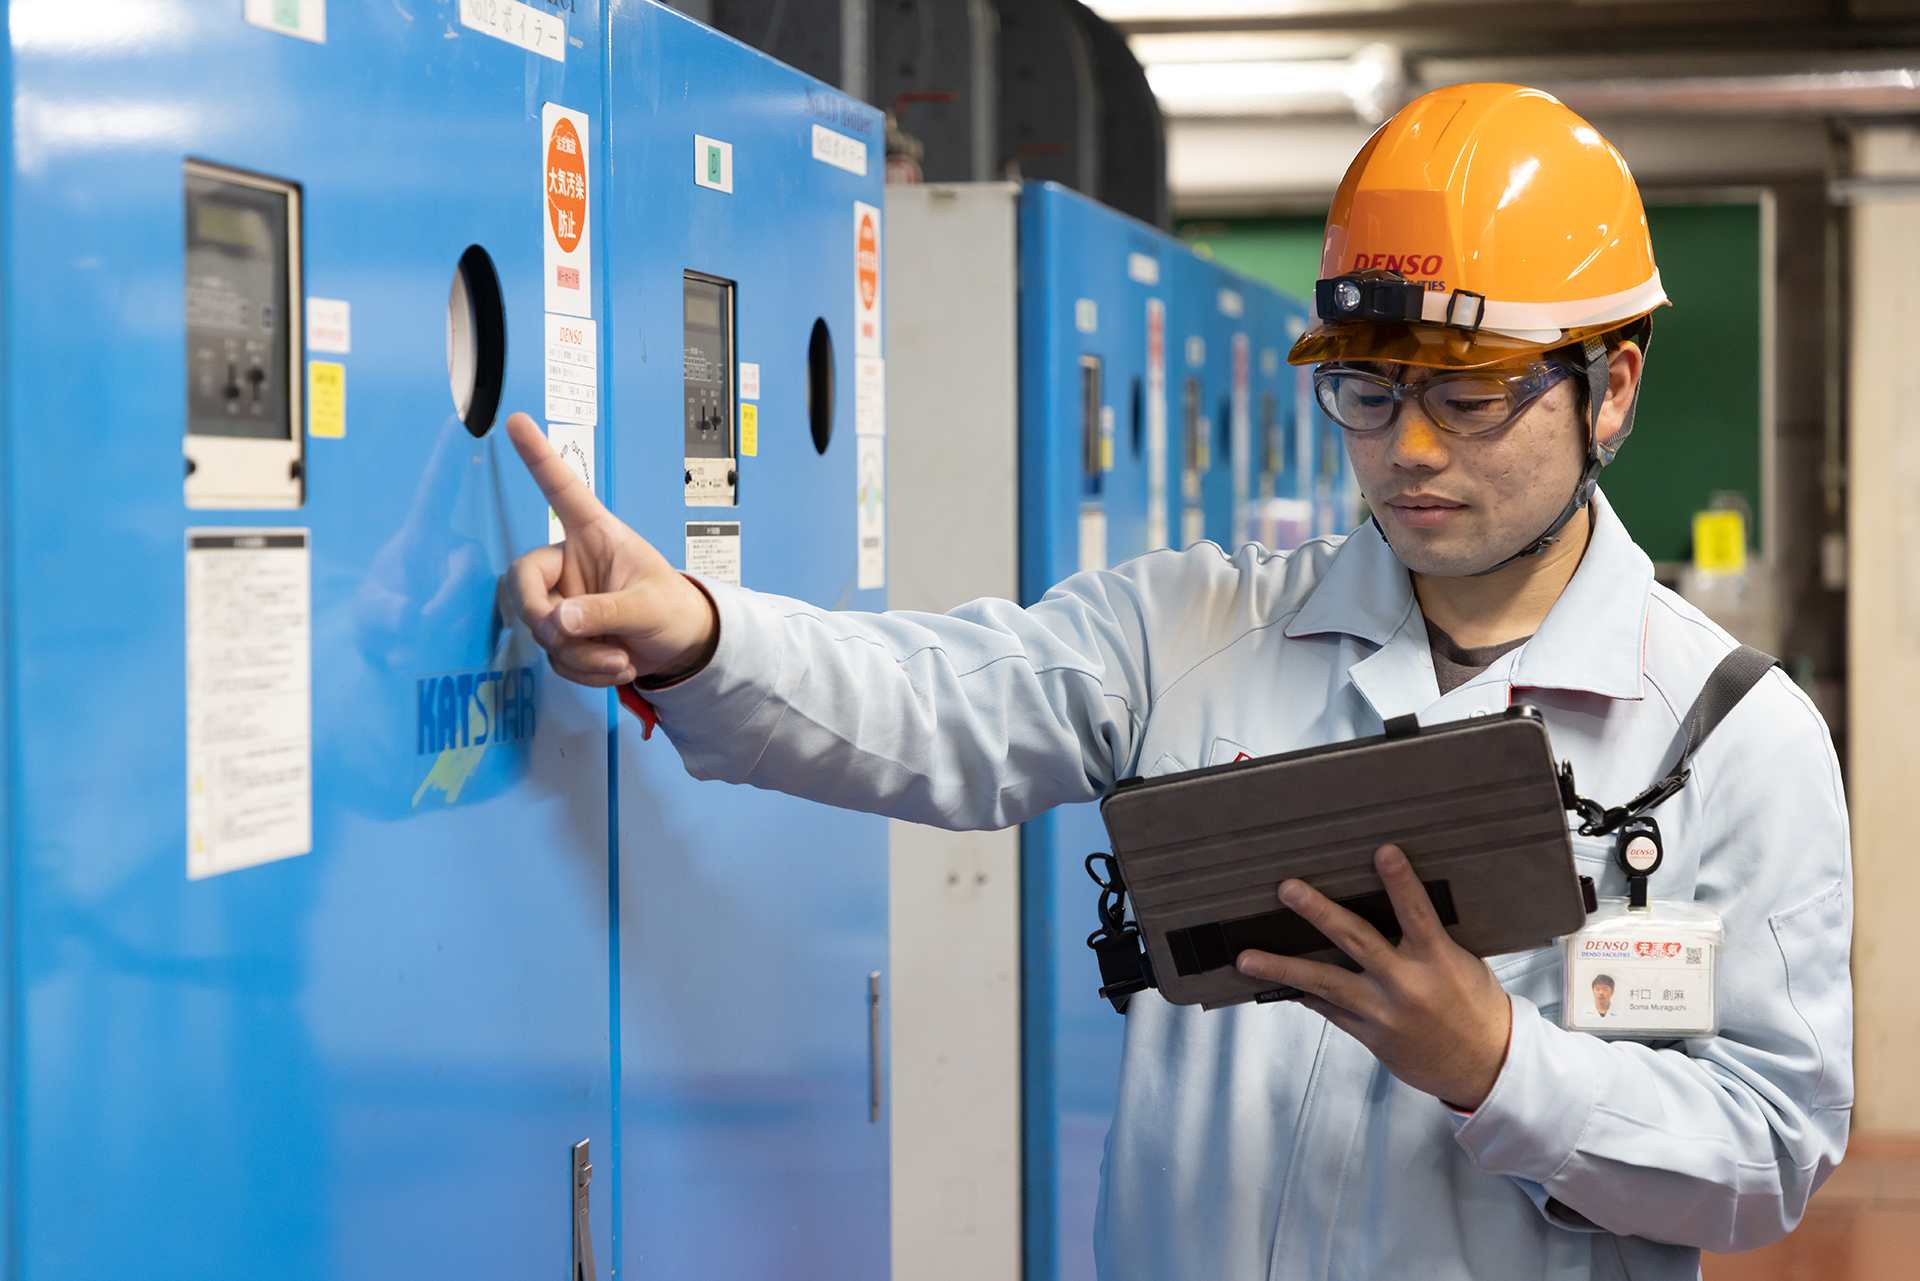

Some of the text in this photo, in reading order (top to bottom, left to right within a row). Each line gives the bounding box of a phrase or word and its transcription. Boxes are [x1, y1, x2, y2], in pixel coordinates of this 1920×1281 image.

[548, 166, 585, 201] 大気汚染
[558, 209, 577, 239] 防止
[1353, 253, 1443, 276] DENSO
[560, 326, 583, 345] DENSO
[417, 668, 536, 755] KATSTAR
[1585, 941, 1629, 951] DENSO
[1629, 989, 1652, 1000] 村口
[1629, 1003, 1687, 1013] Soma Muraguchi
